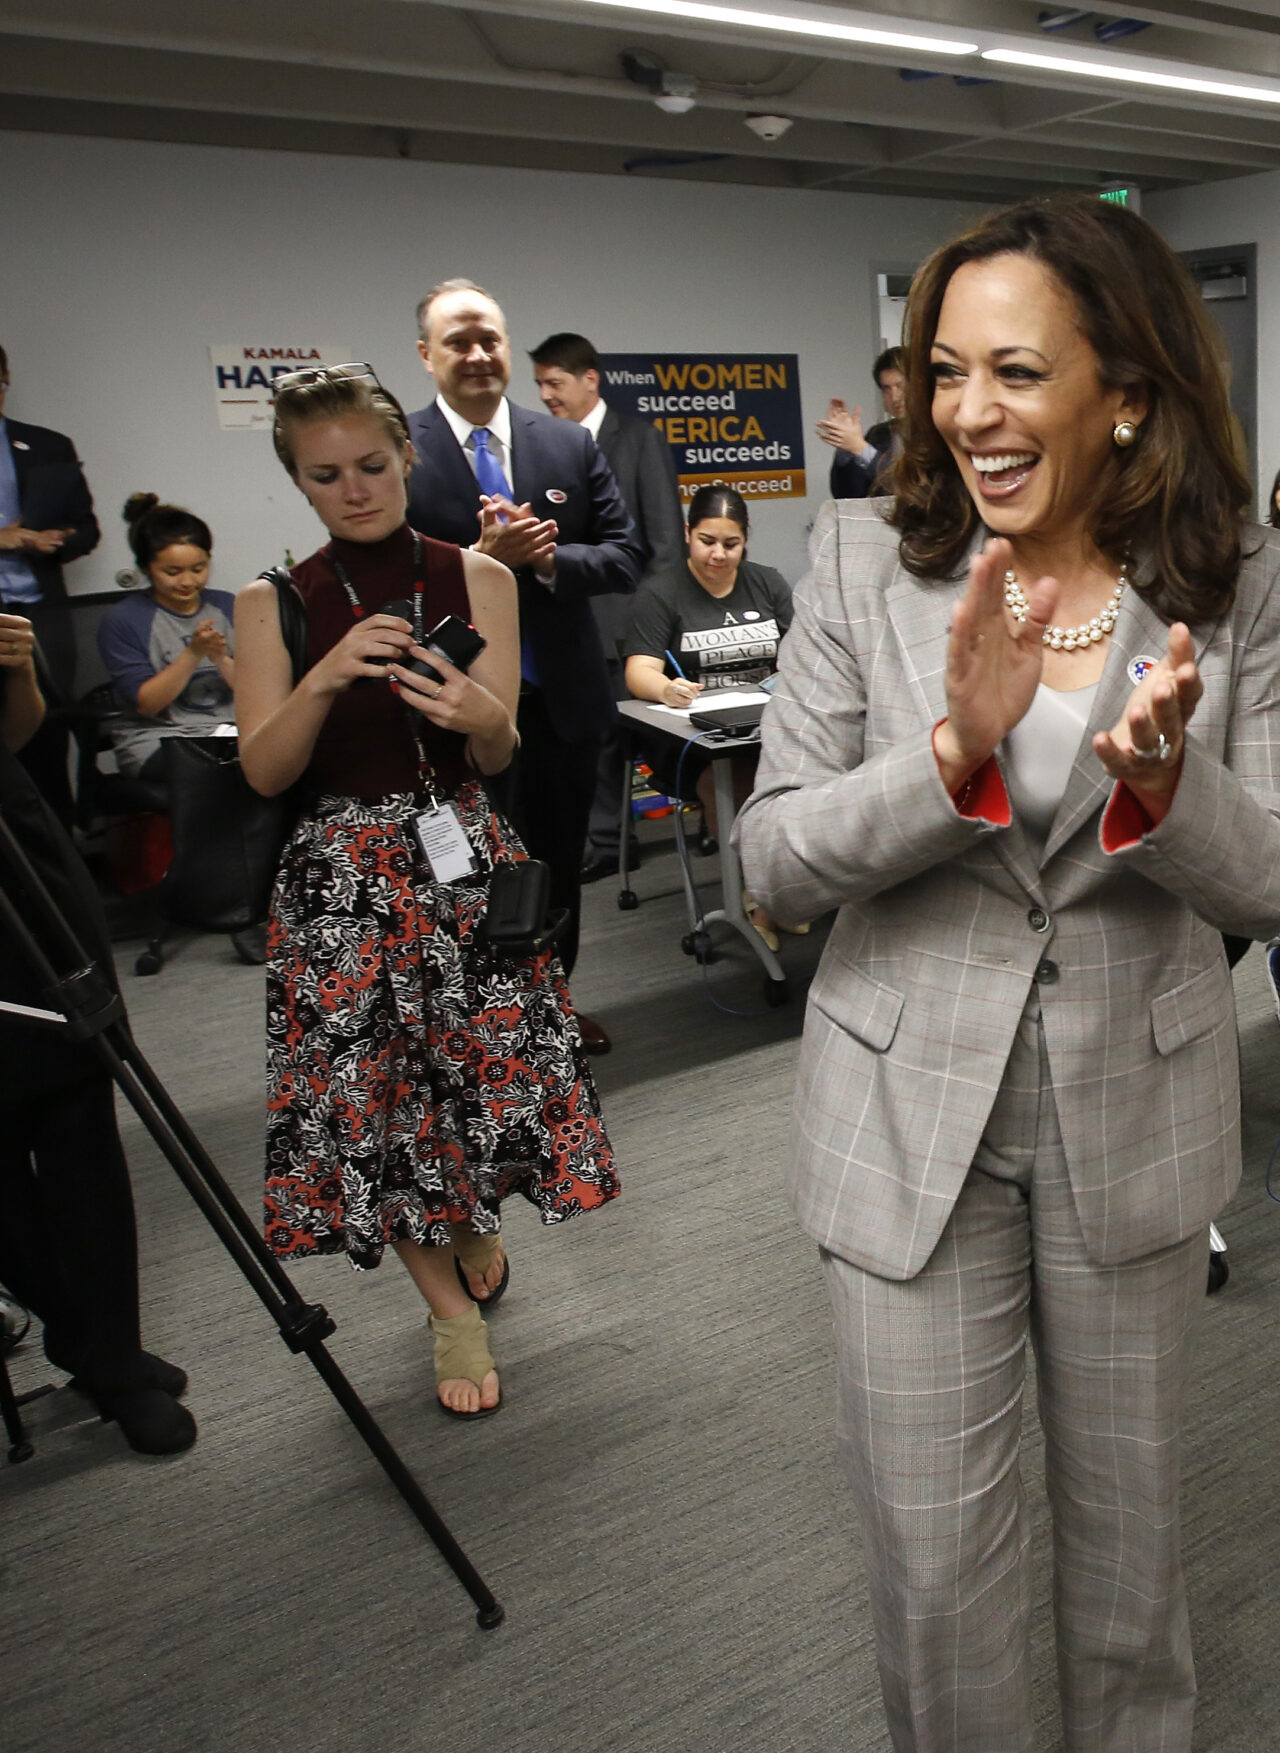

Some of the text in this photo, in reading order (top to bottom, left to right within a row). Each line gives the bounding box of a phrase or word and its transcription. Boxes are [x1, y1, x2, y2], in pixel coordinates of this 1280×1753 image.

[243, 347, 321, 360] KAMALA
[605, 363, 787, 390] When WOMEN
[637, 390, 736, 412] succeed
[653, 415, 765, 444] ERICA
[685, 441, 791, 464] succeeds
[723, 612, 739, 625] A
[684, 622, 778, 649] WOMAN'S
[705, 643, 774, 664] PLACE
